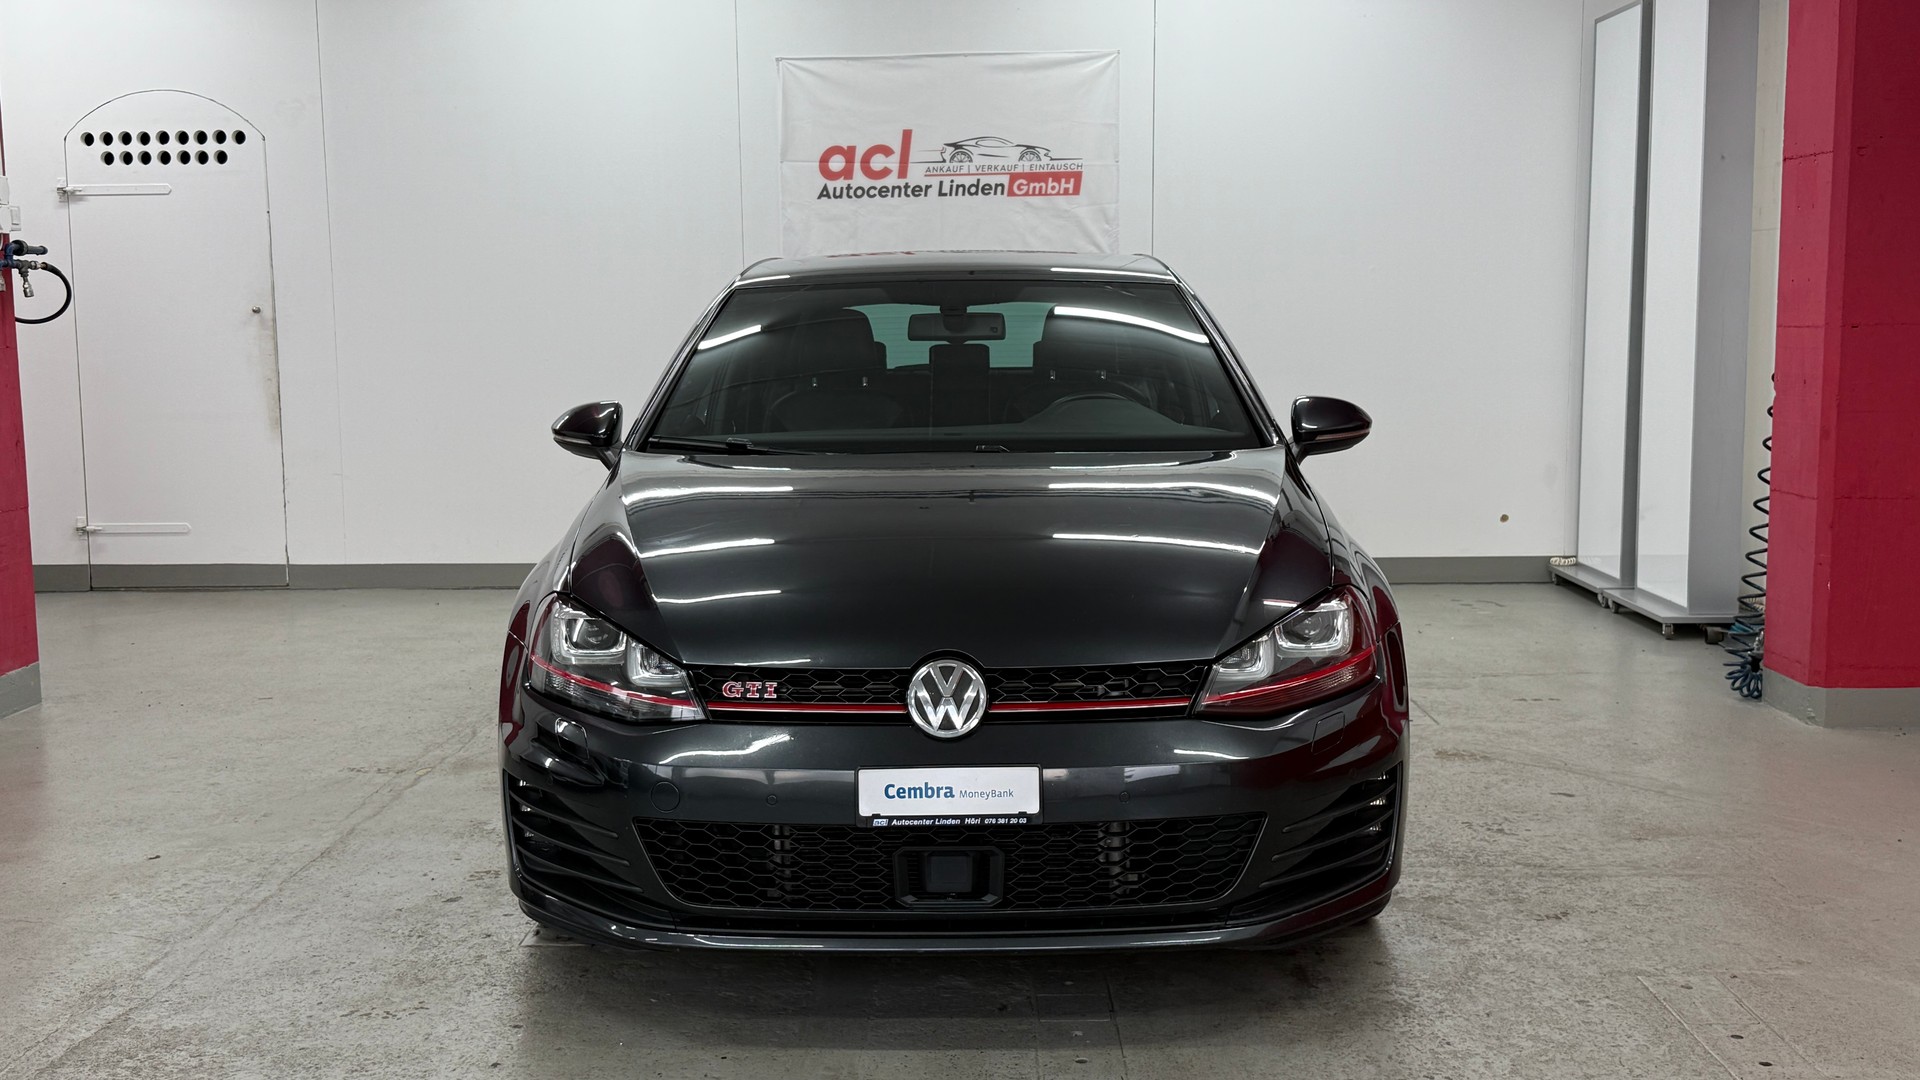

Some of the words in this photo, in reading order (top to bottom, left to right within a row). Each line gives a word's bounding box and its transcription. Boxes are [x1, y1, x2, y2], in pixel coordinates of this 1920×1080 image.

[818, 129, 913, 181] acl
[925, 165, 964, 174] ANKAUF
[975, 164, 1019, 172] VERKAUF
[1029, 163, 1083, 171] EINTAUSCH
[817, 179, 932, 200] Autocenter
[937, 178, 1006, 197] Linden
[1013, 178, 1075, 195] GmbH
[722, 681, 778, 699] GTI
[884, 782, 955, 800] Cembra
[959, 788, 1014, 801] MoneyBank
[891, 818, 934, 826] Autocenter
